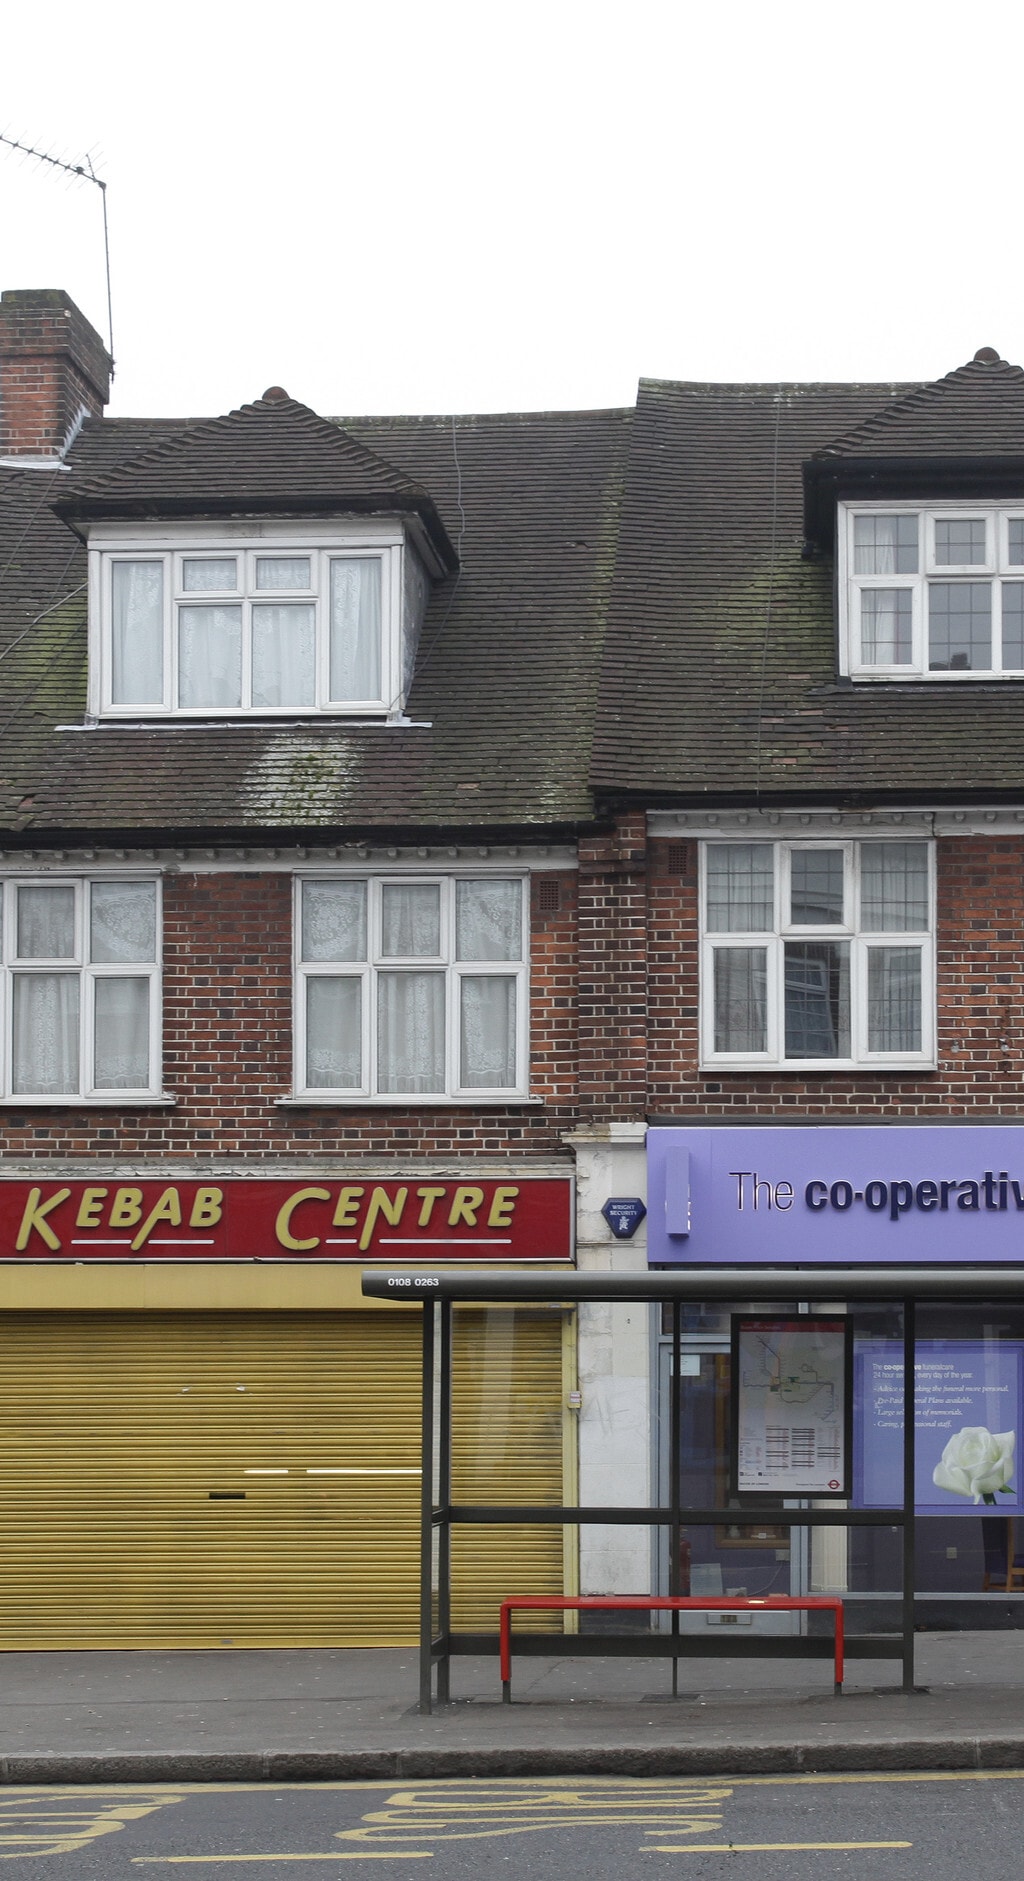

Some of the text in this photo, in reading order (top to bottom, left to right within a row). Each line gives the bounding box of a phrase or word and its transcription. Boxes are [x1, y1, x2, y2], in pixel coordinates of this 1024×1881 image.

[728, 1171, 795, 1211] The
[15, 1186, 520, 1252] KEBAB CENTRE
[388, 1278, 440, 1287] 0108 0263
